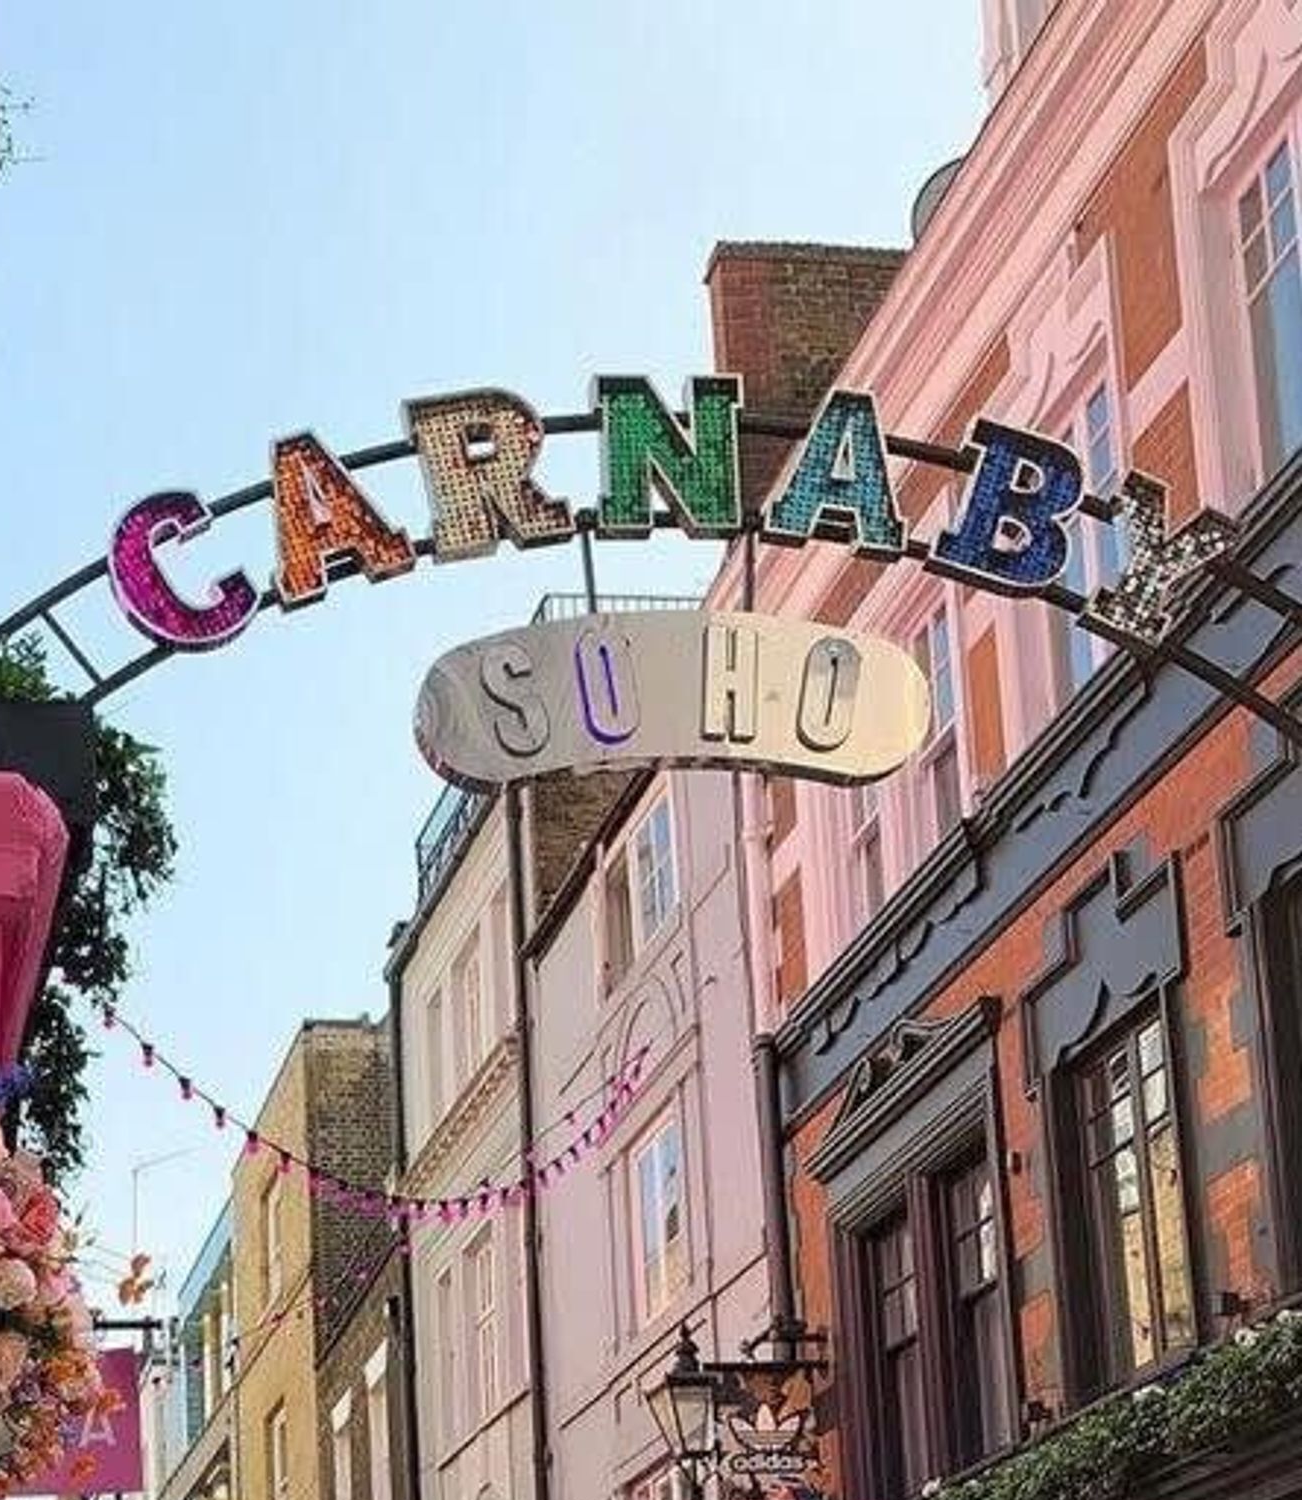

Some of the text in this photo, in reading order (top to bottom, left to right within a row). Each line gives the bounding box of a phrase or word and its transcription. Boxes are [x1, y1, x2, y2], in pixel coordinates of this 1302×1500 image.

[106, 374, 1240, 652] CARNABY
[479, 627, 863, 758] SOHO
[733, 1452, 804, 1470] adidas
